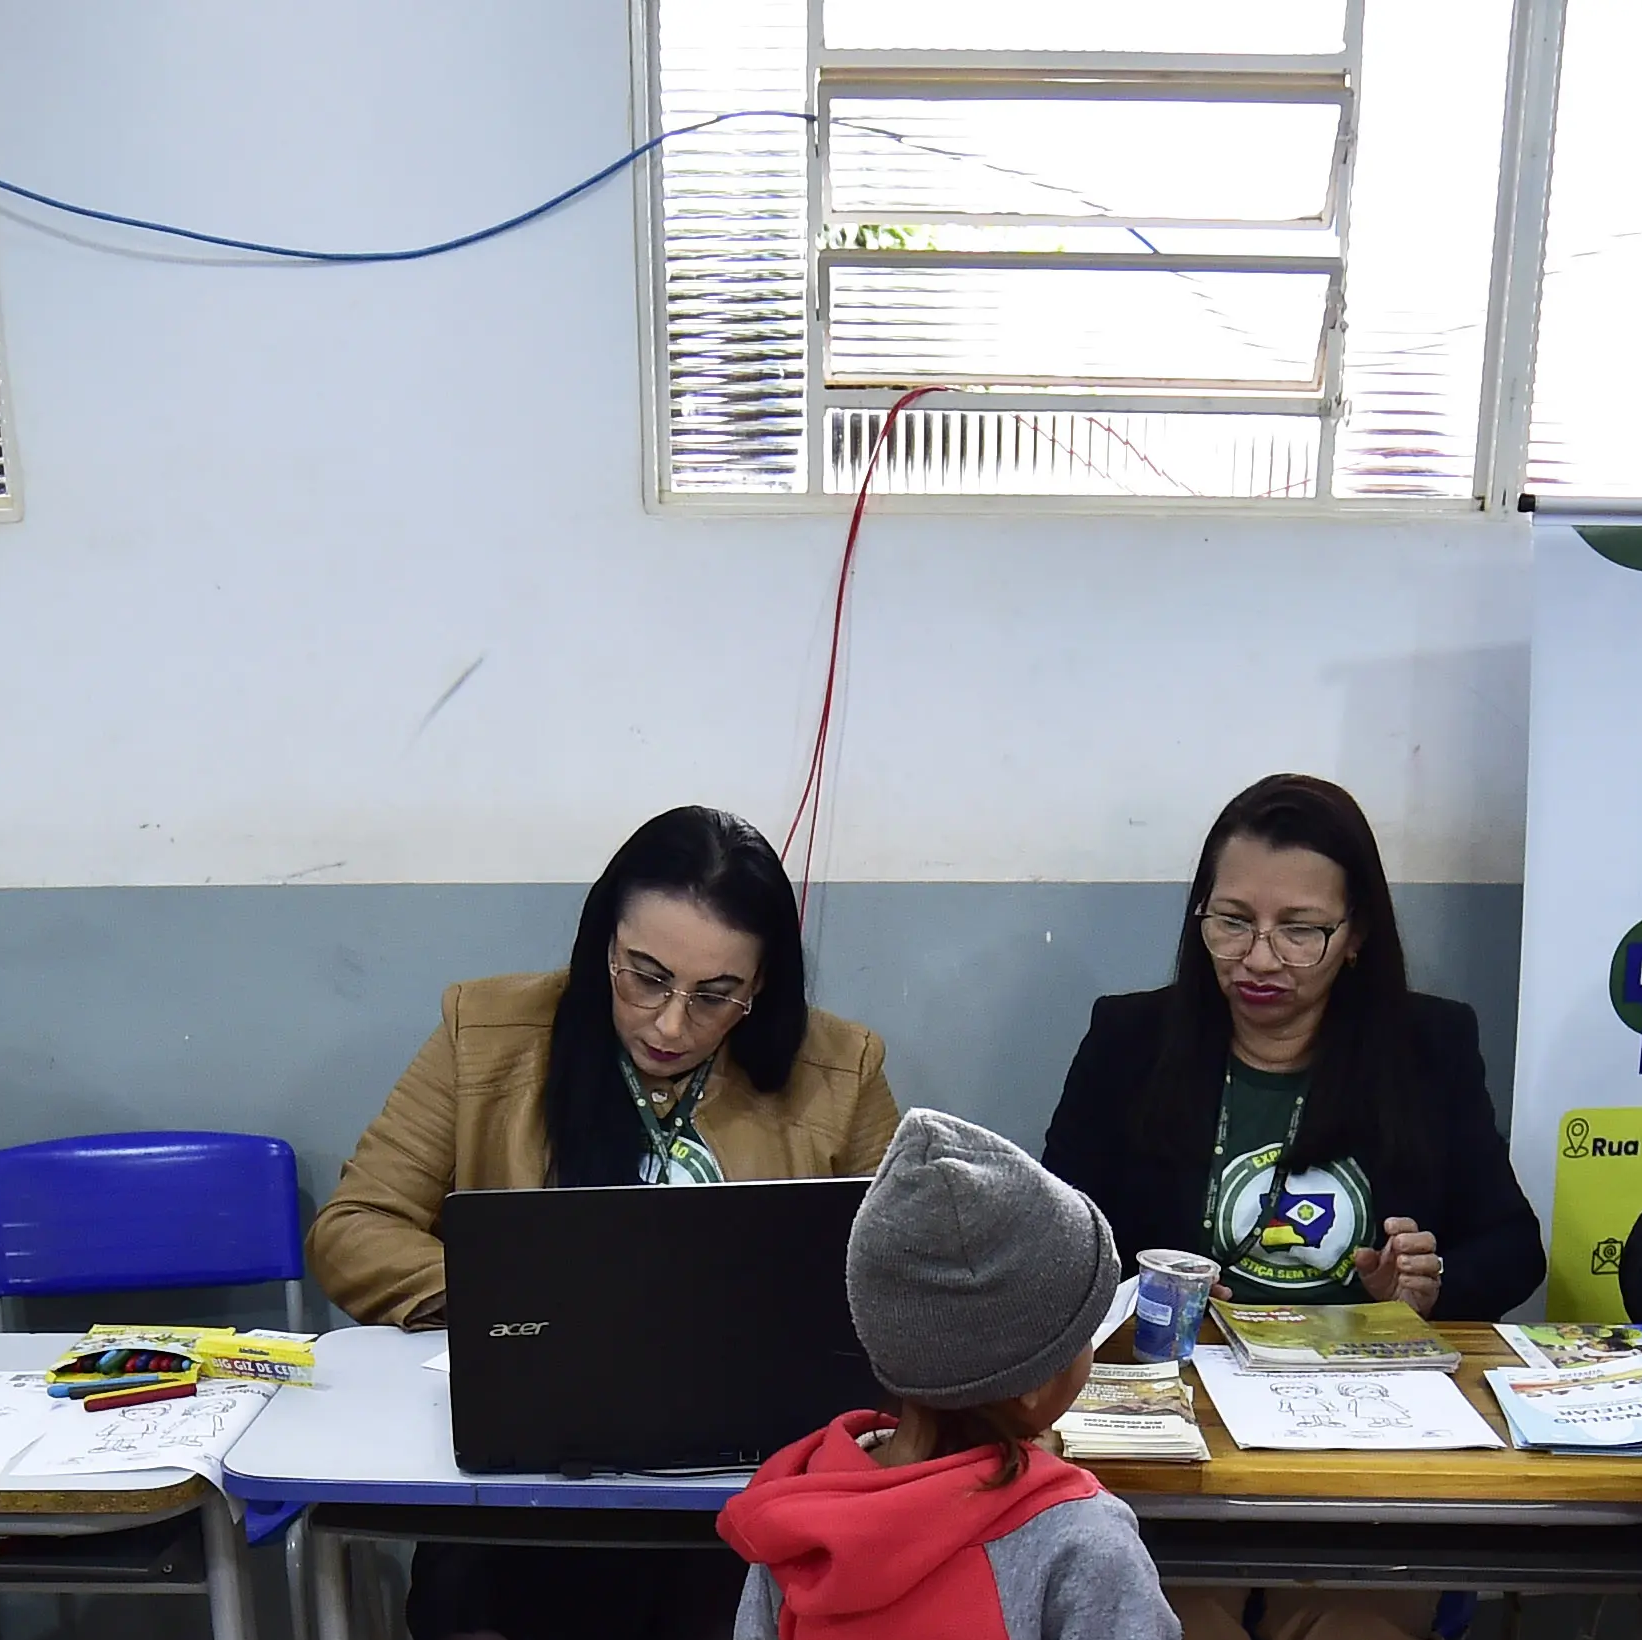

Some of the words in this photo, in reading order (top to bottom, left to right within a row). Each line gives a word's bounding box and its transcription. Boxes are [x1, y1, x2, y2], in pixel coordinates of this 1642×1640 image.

[1591, 1138, 1639, 1157] Rua
[488, 1321, 550, 1337] acer
[211, 1356, 233, 1370] BIG
[233, 1359, 256, 1372] GIZ
[255, 1362, 273, 1374] DE
